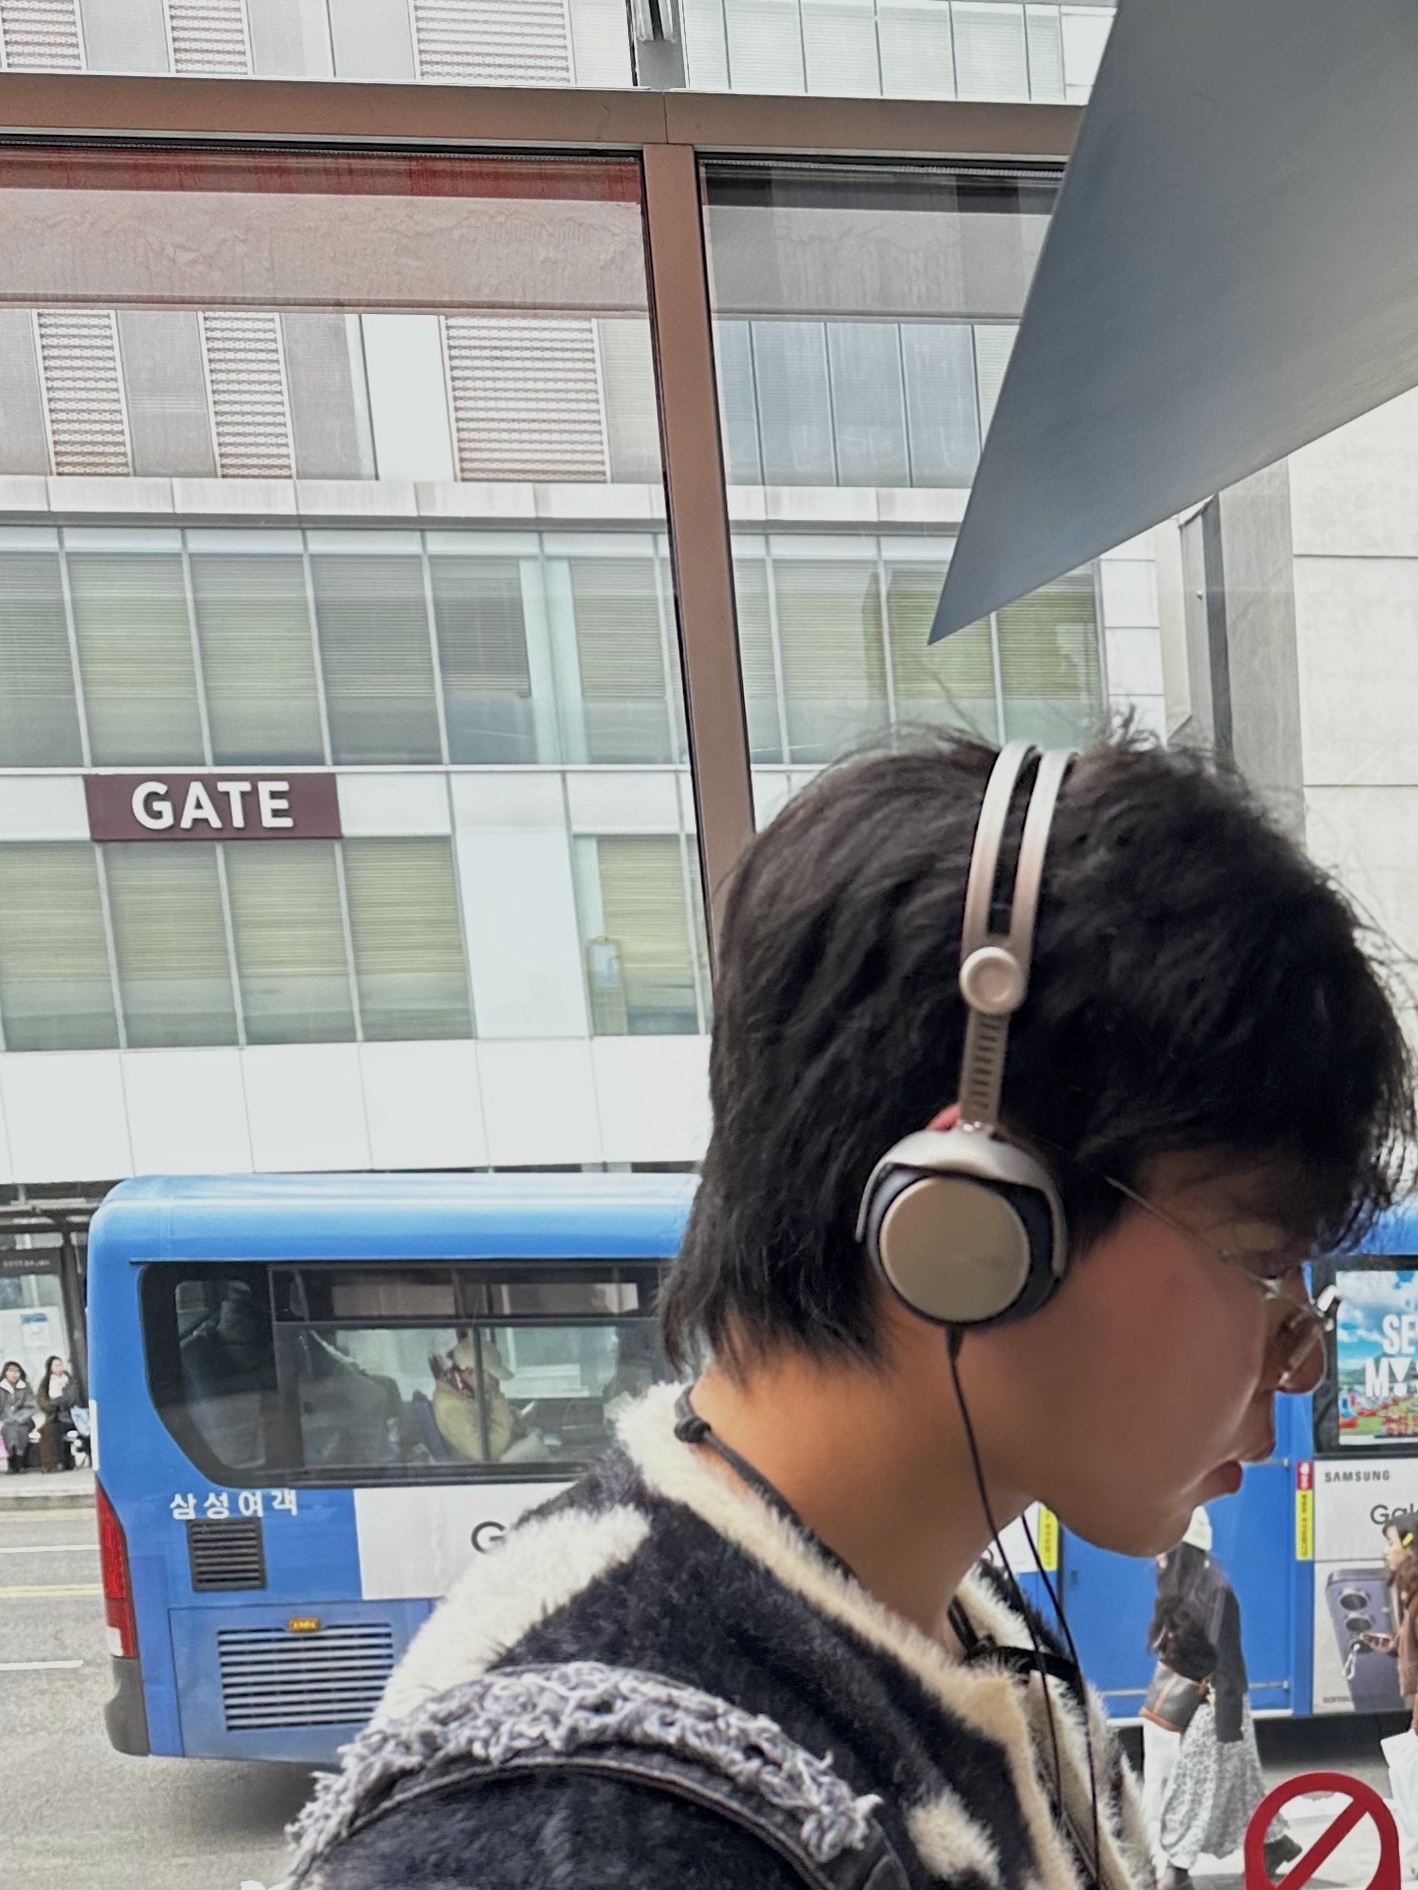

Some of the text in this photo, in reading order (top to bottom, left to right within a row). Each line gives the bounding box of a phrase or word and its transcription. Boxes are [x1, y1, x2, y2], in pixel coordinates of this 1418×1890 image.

[132, 782, 294, 829] GATE
[1325, 1470, 1389, 1483] SAMSUNG
[169, 1489, 298, 1520] 삼성여객
